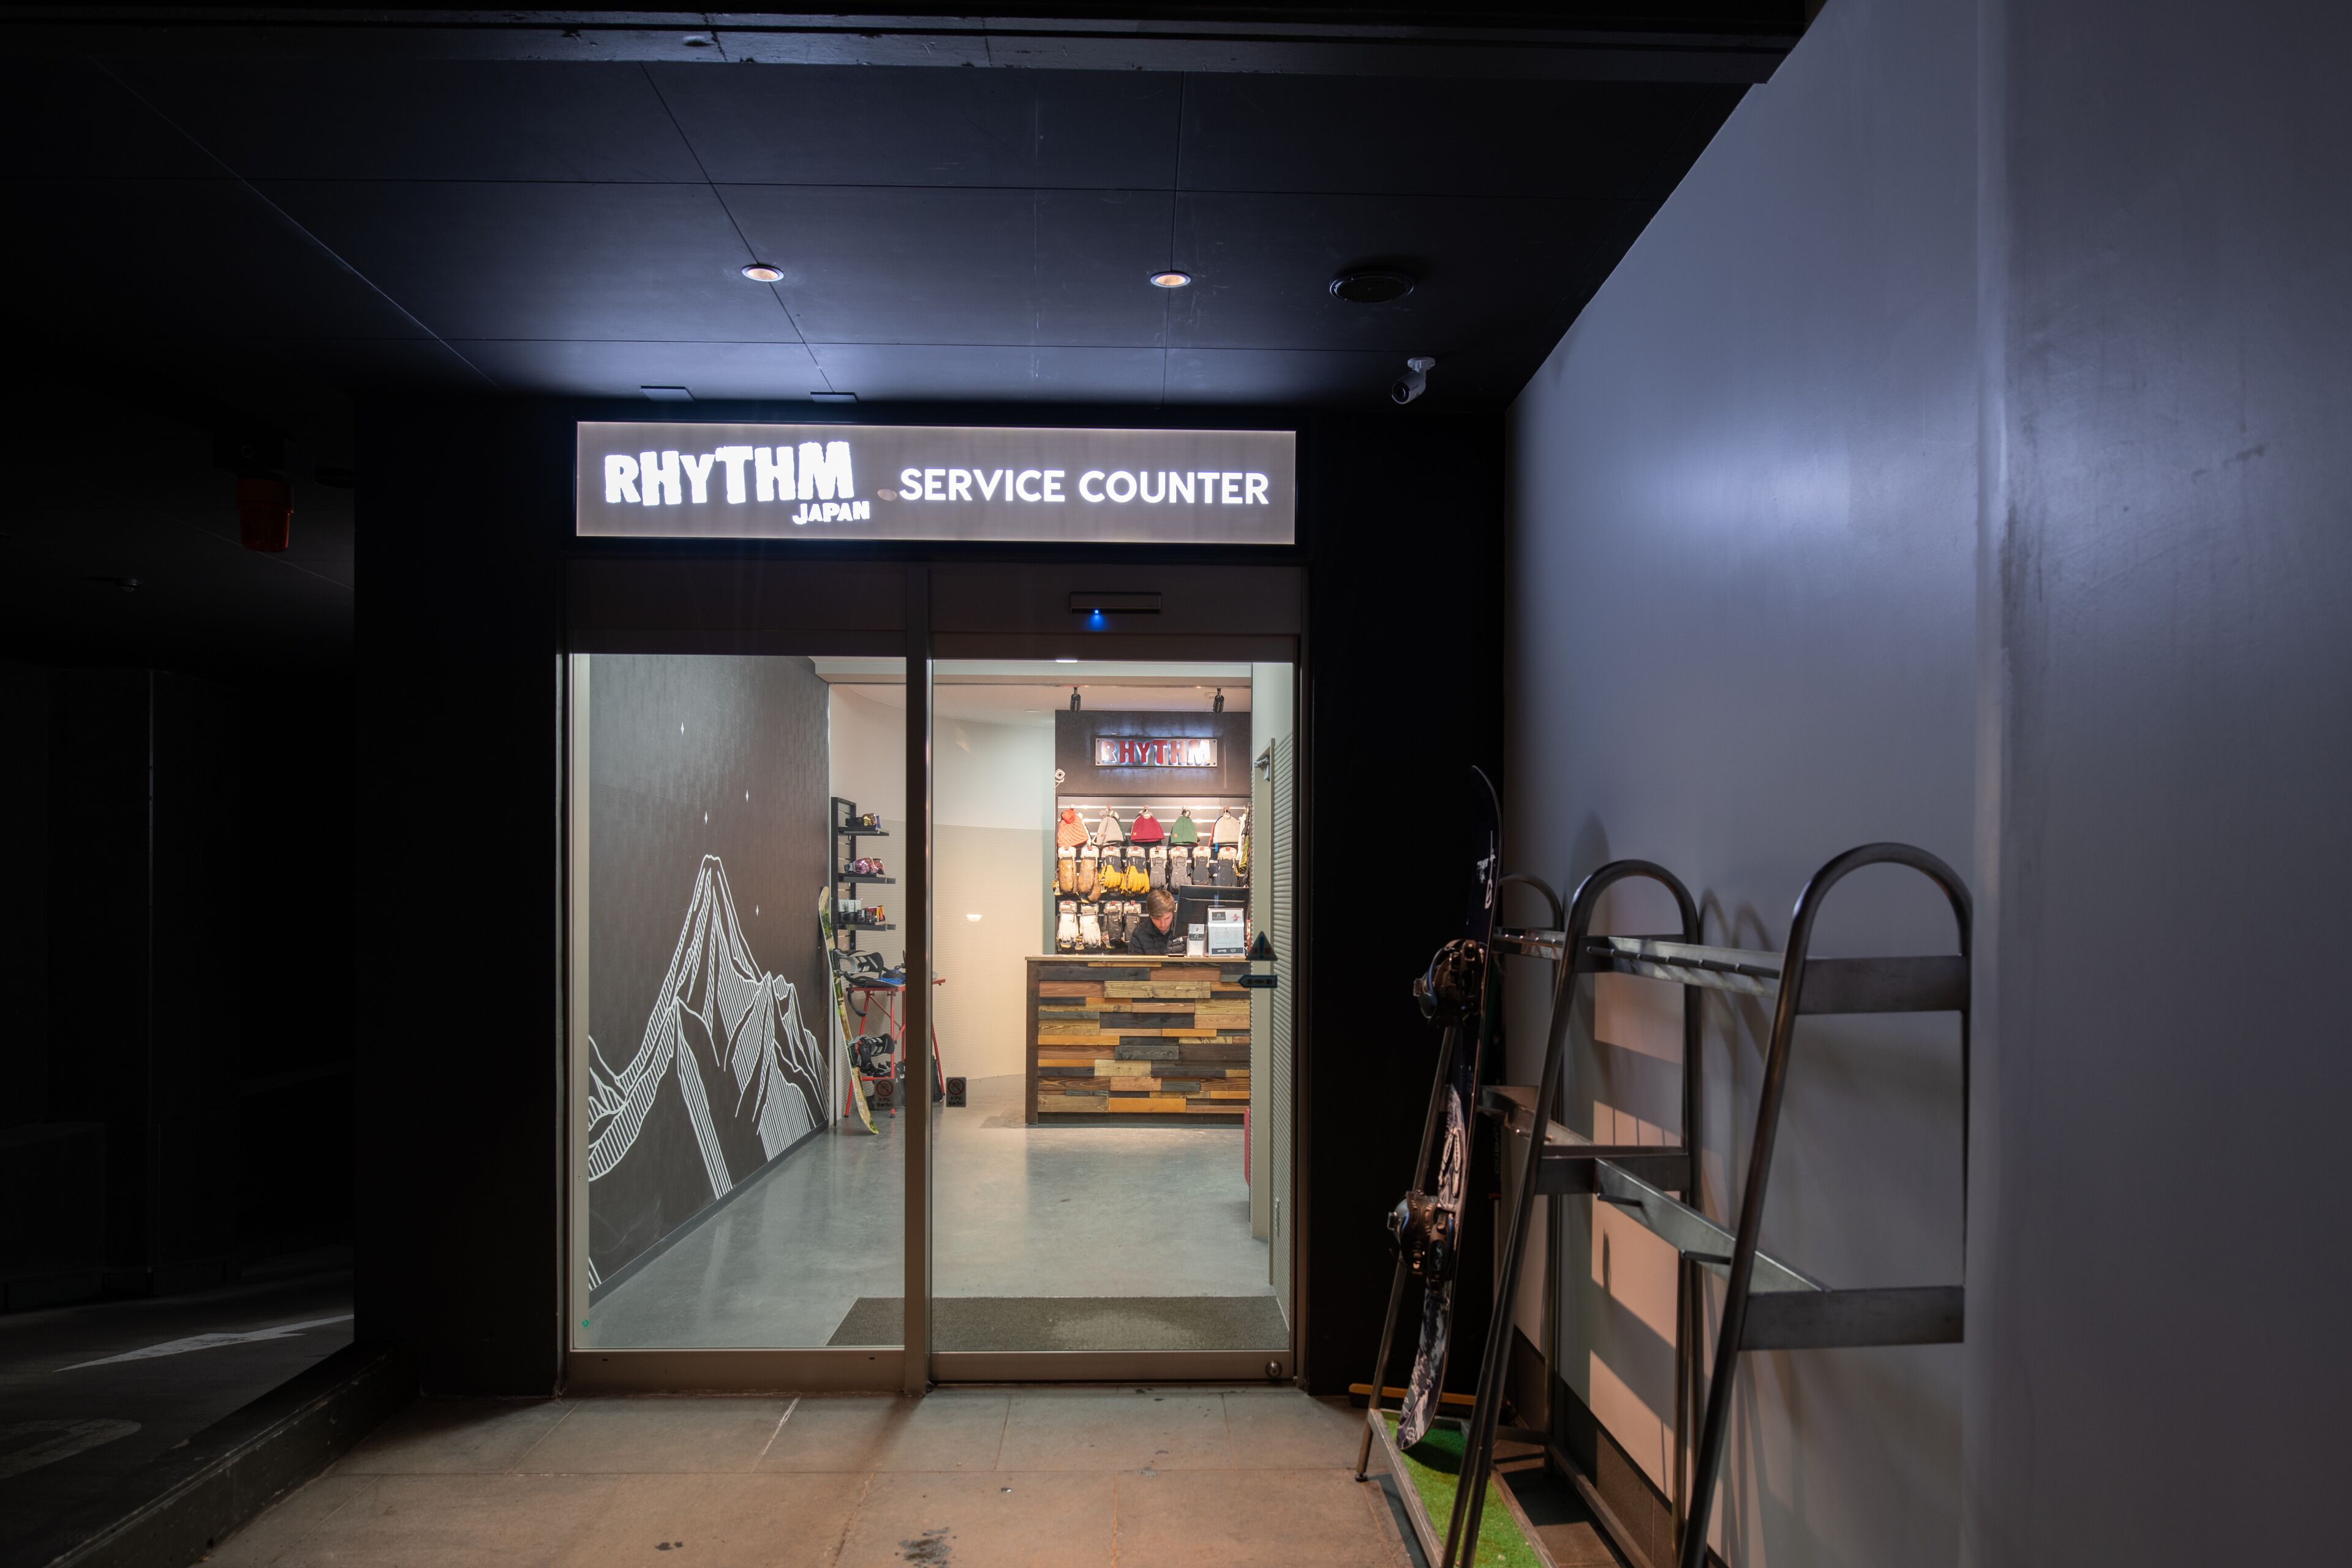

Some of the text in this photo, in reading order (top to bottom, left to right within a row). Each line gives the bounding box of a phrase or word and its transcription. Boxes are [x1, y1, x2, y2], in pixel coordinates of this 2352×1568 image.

[605, 441, 854, 506] RHYTHM
[899, 468, 1270, 505] SERVICE COUNTER
[792, 501, 870, 525] JAPAN
[1101, 739, 1211, 765] RHYTHM
